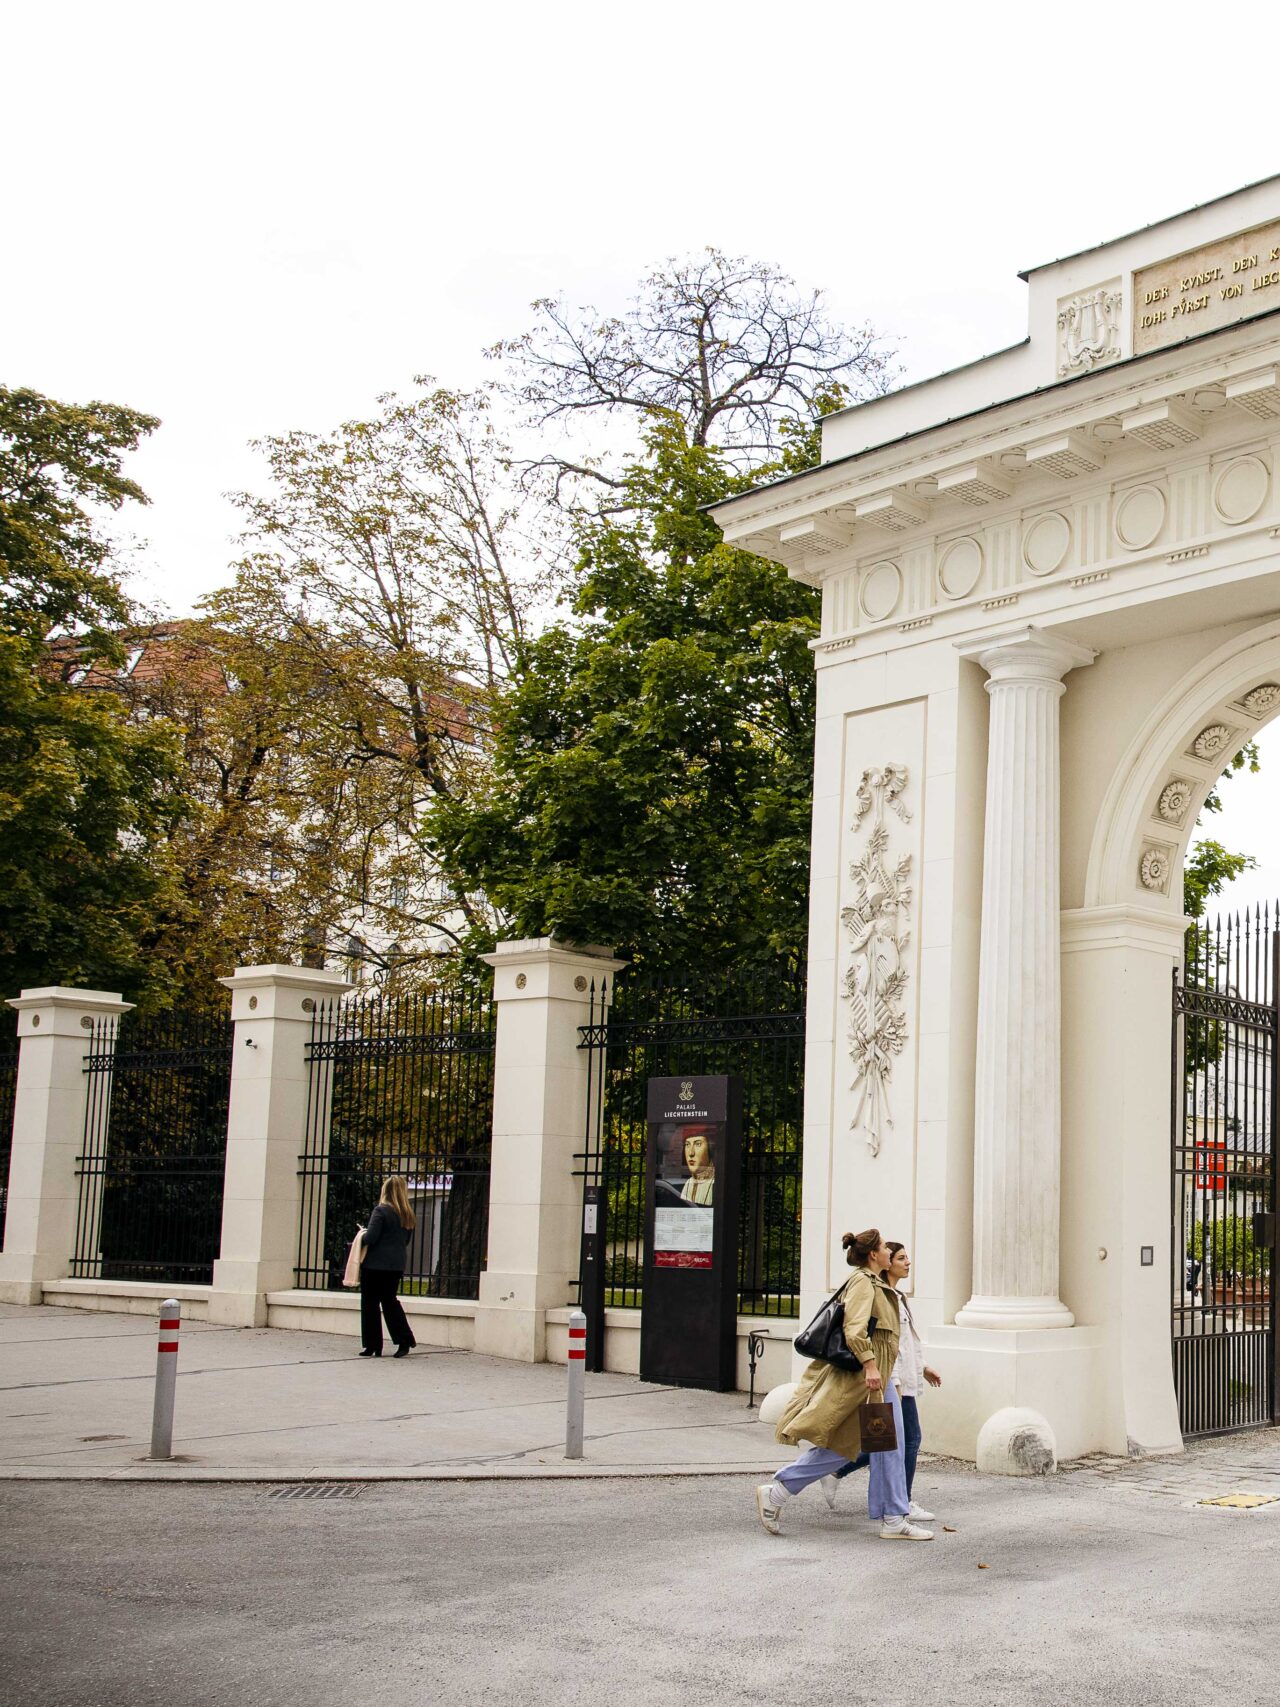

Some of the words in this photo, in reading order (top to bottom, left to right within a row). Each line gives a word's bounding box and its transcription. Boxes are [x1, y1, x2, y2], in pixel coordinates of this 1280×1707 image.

[1144, 286, 1169, 305] DER
[1232, 254, 1258, 274] DEN
[1219, 284, 1243, 301] VON
[664, 1110, 708, 1118] LIECHTENSTEIN
